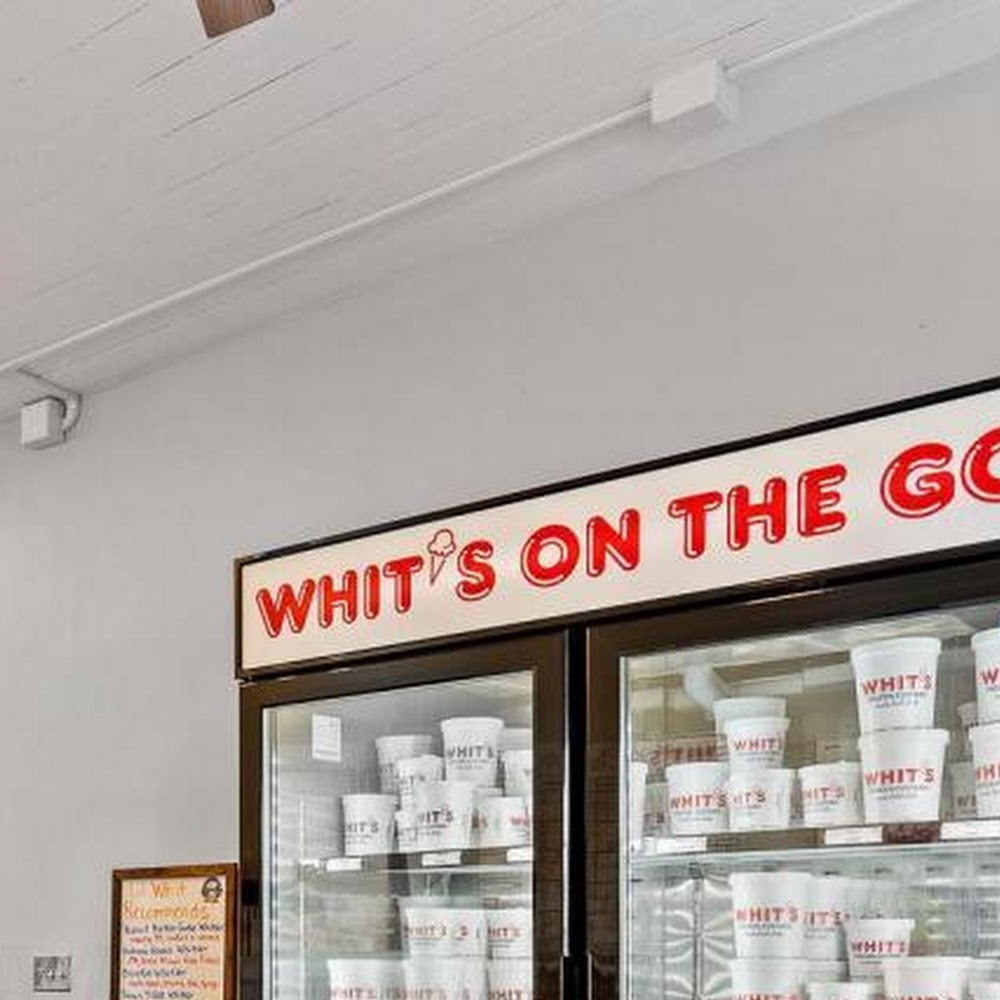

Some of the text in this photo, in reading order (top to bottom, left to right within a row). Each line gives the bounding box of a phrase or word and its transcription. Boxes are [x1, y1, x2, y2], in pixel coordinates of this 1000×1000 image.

[255, 528, 496, 638] WHIT'S
[520, 508, 641, 588] ON
[668, 463, 848, 559] THE
[863, 672, 932, 694] WHIT'S
[864, 768, 935, 786] WHIT'S
